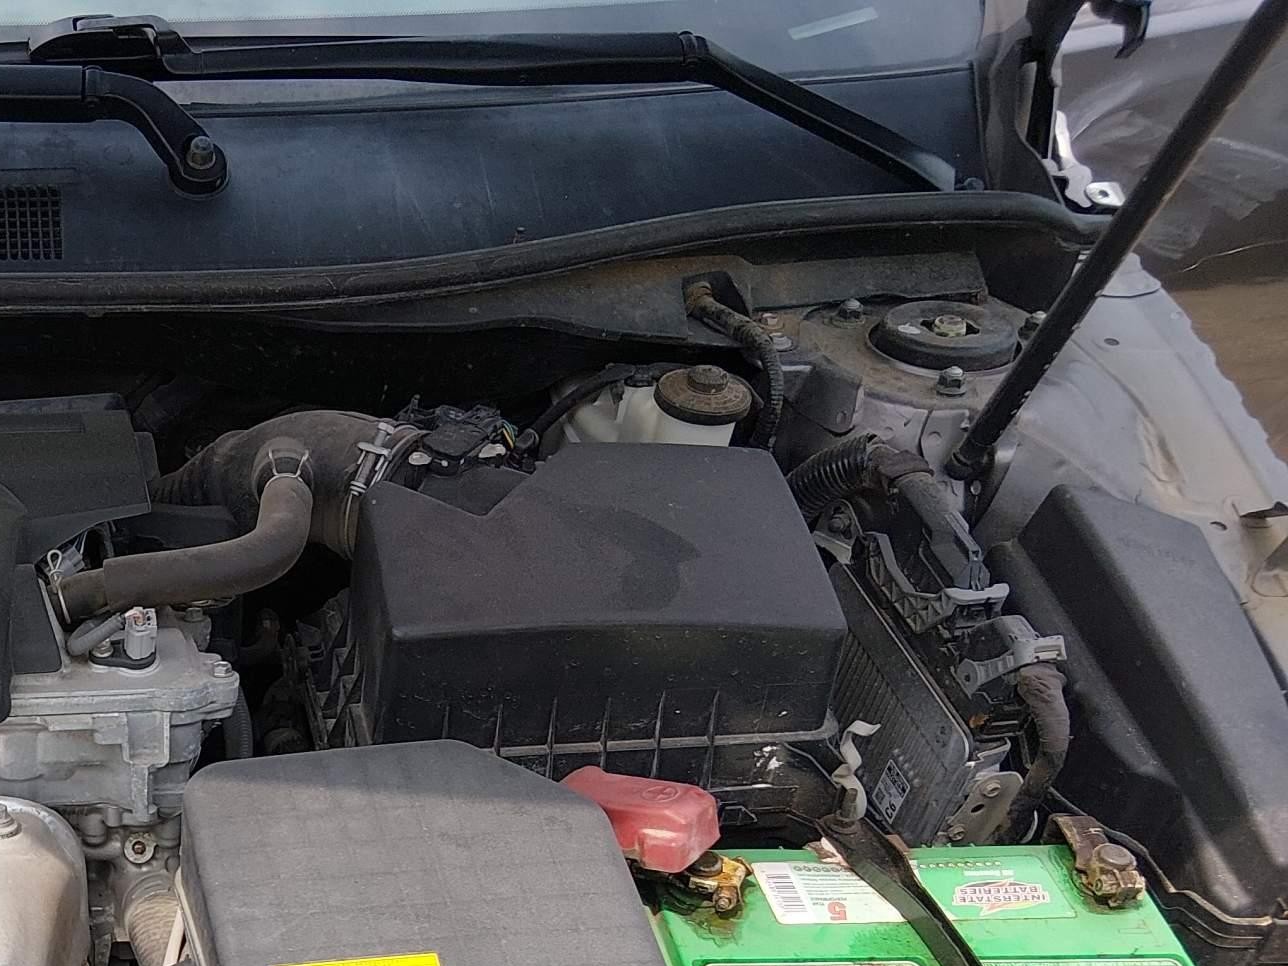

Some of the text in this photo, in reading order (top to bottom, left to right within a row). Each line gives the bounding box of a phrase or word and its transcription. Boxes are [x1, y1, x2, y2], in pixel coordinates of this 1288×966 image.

[884, 800, 898, 819] C6
[959, 885, 1039, 895] BATTERIES
[957, 893, 1047, 903] INTERSTATE
[827, 901, 847, 921] 5
